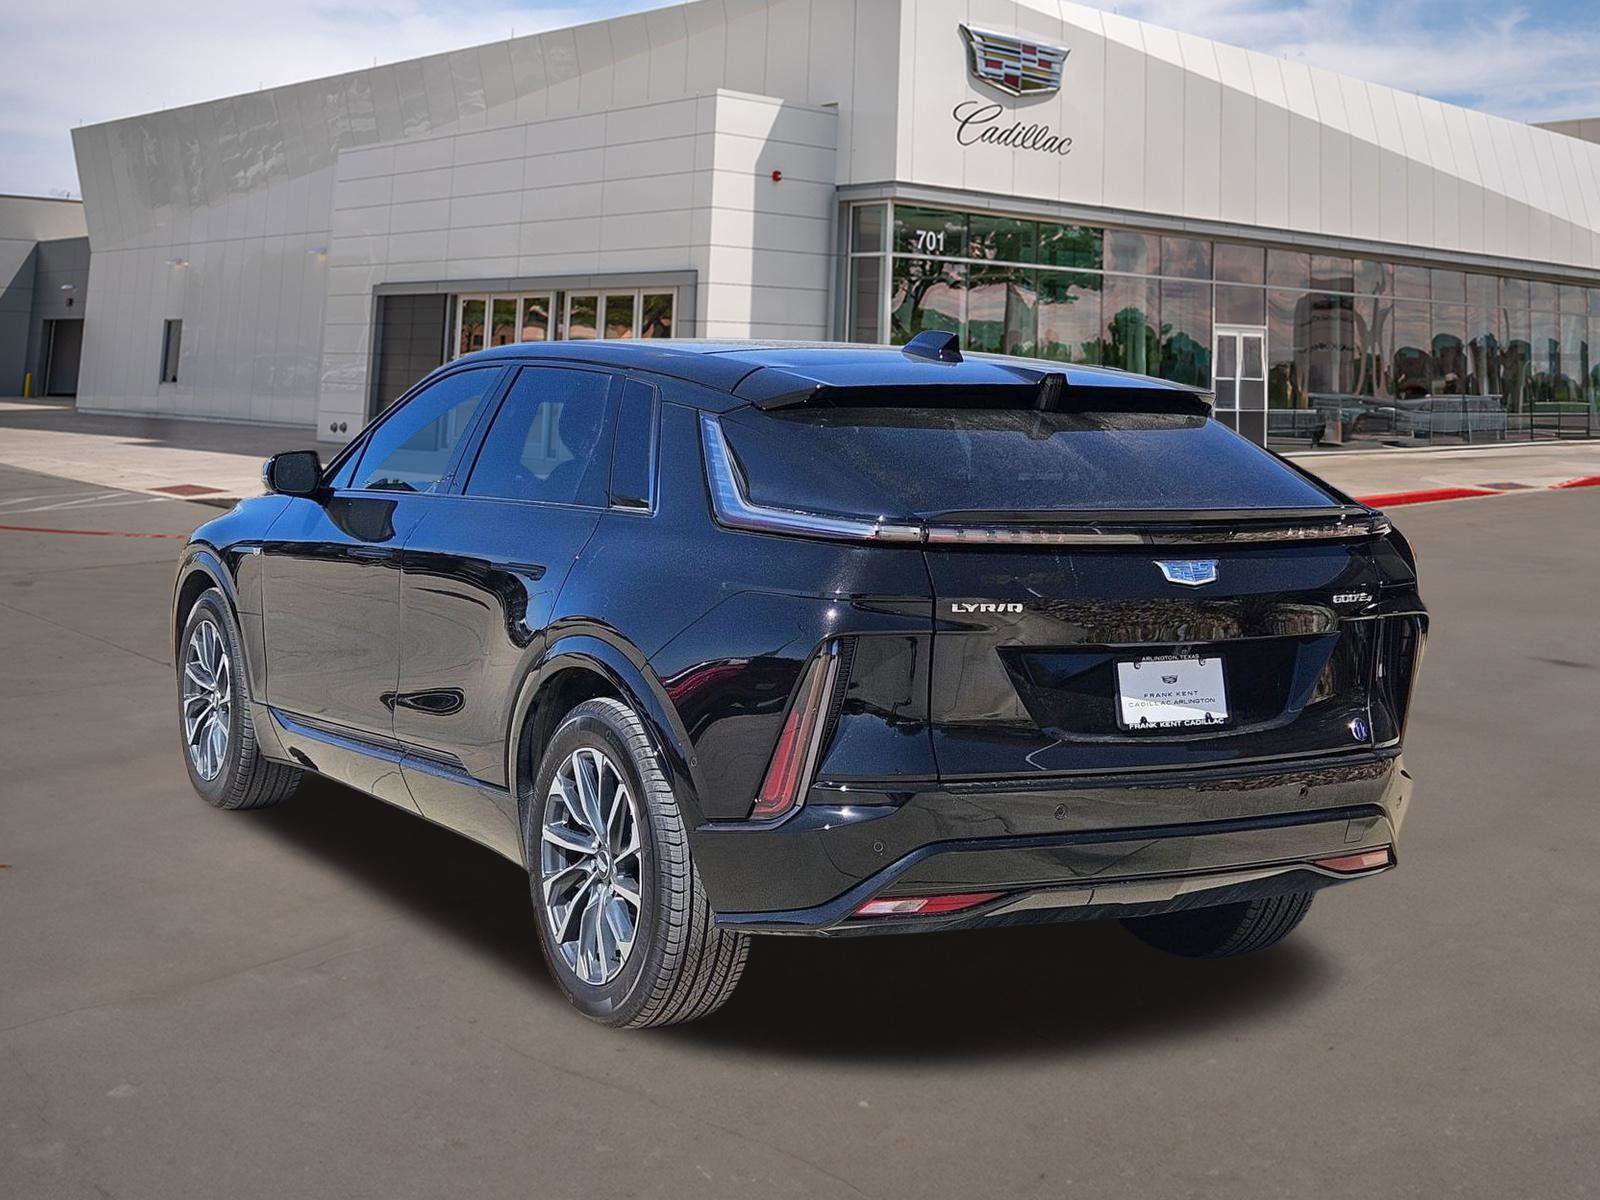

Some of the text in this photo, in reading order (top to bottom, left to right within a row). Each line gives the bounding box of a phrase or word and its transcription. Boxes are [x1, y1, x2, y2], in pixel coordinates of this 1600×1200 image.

[953, 101, 1072, 156] Cadillac
[916, 229, 945, 252] 701
[1173, 697, 1216, 705] ARLINGTON
[1129, 721, 1158, 730] FRANK
[1160, 719, 1182, 728] KENT
